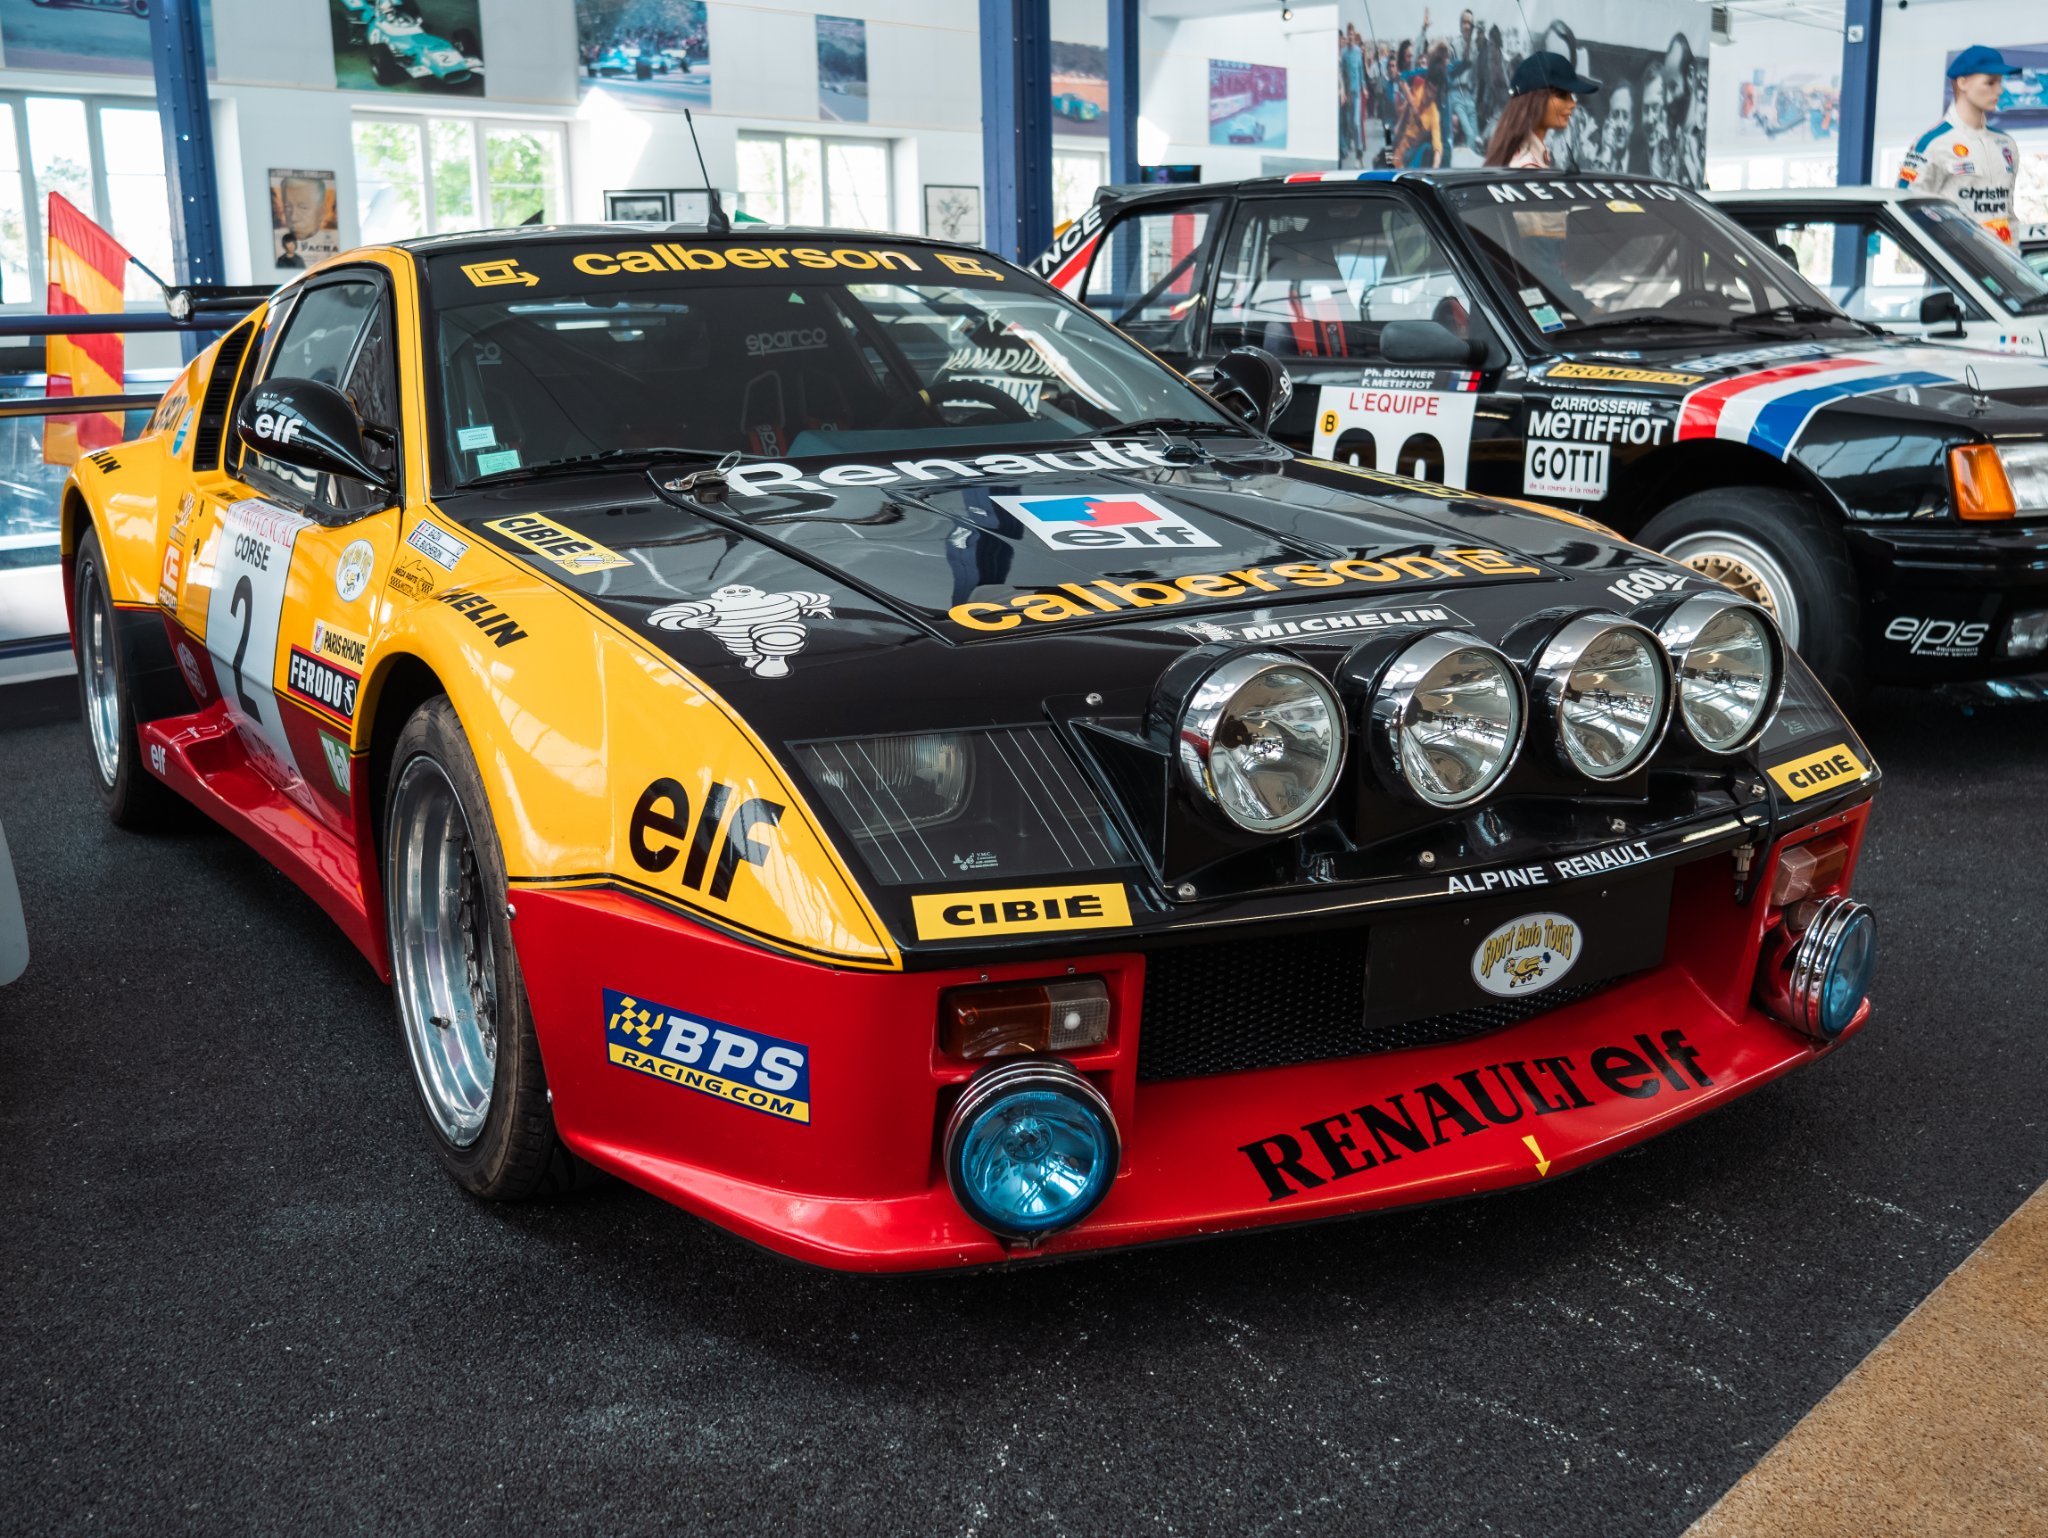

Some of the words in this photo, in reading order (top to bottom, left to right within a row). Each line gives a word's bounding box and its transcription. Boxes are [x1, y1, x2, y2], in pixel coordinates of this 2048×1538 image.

[1486, 181, 1681, 204] METIFFIOT
[1958, 186, 2010, 199] christin
[1041, 204, 1102, 275] NCE
[572, 243, 923, 277] calberson
[745, 326, 829, 355] sparco
[1372, 379, 1434, 390] METIFFIOT
[1383, 369, 1436, 380] BOUVIER
[1556, 364, 1701, 385] PROMOTION
[1348, 391, 1441, 417] L'EQUIPE
[1551, 396, 1652, 416] CARROSSERIE
[254, 413, 304, 444] elf
[1324, 413, 1335, 434] B
[722, 440, 1192, 497] Renault
[1531, 445, 1602, 484] GOTTI
[234, 533, 271, 572] CORSE
[1051, 526, 1195, 547] elf
[948, 554, 1465, 632] calberson
[1606, 567, 1684, 606] IGOL
[1240, 607, 1449, 641] MICHELIN
[230, 575, 264, 726] 2
[290, 654, 344, 708] FERODO
[150, 744, 167, 776] elf
[628, 776, 786, 902] elf
[1447, 865, 1549, 896] ALPINE
[1555, 841, 1652, 881] RENAULT
[1481, 925, 1516, 979] Sport
[1514, 920, 1543, 951] Auto
[1544, 918, 1575, 961] Tours
[660, 1014, 805, 1093] BPS
[621, 1050, 797, 1117] RACING.COM
[1237, 1054, 1597, 1203] RENAULT
[1589, 1028, 1715, 1100] elf
